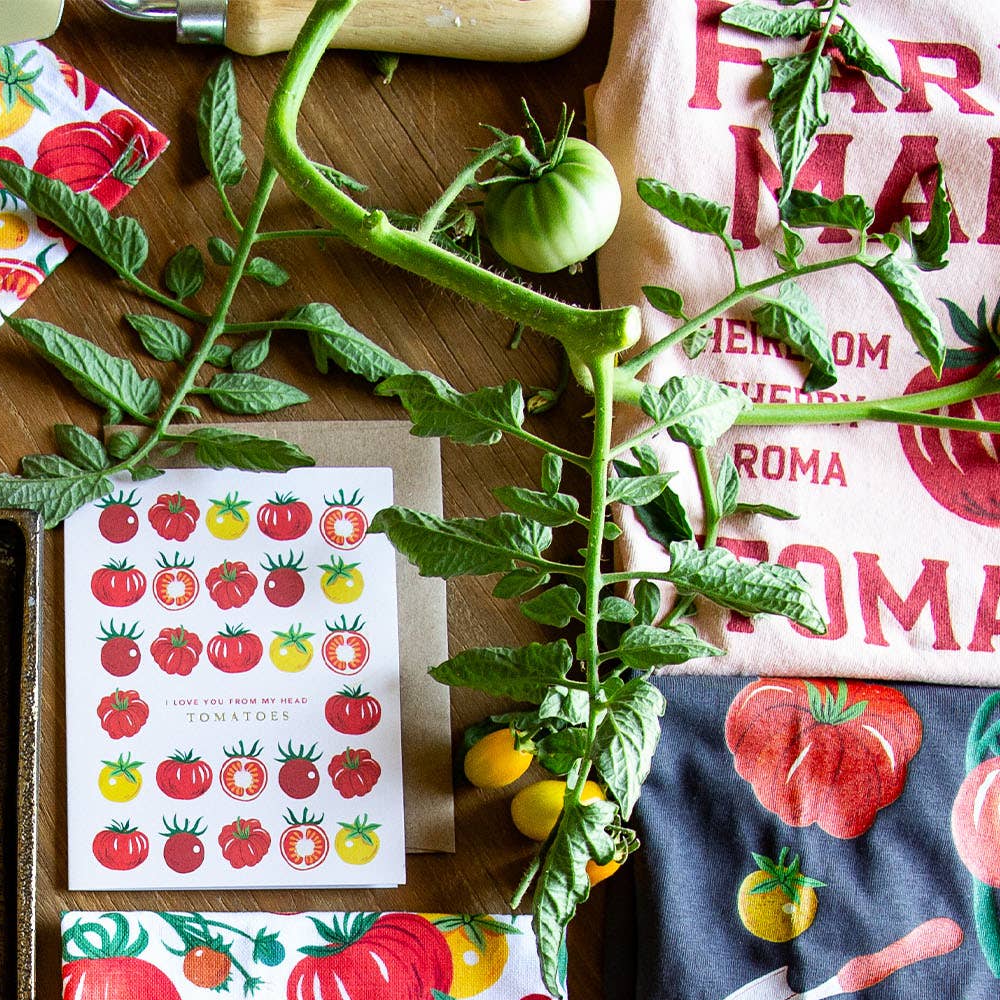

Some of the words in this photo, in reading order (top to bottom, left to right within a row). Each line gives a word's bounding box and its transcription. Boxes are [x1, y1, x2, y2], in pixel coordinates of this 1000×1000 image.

[688, 0, 1000, 116] FR
[733, 443, 848, 488] ROMA
[204, 698, 224, 706] YOU
[261, 697, 276, 705] MY
[280, 697, 308, 705] HEAD
[186, 711, 290, 723] TOMATOES
